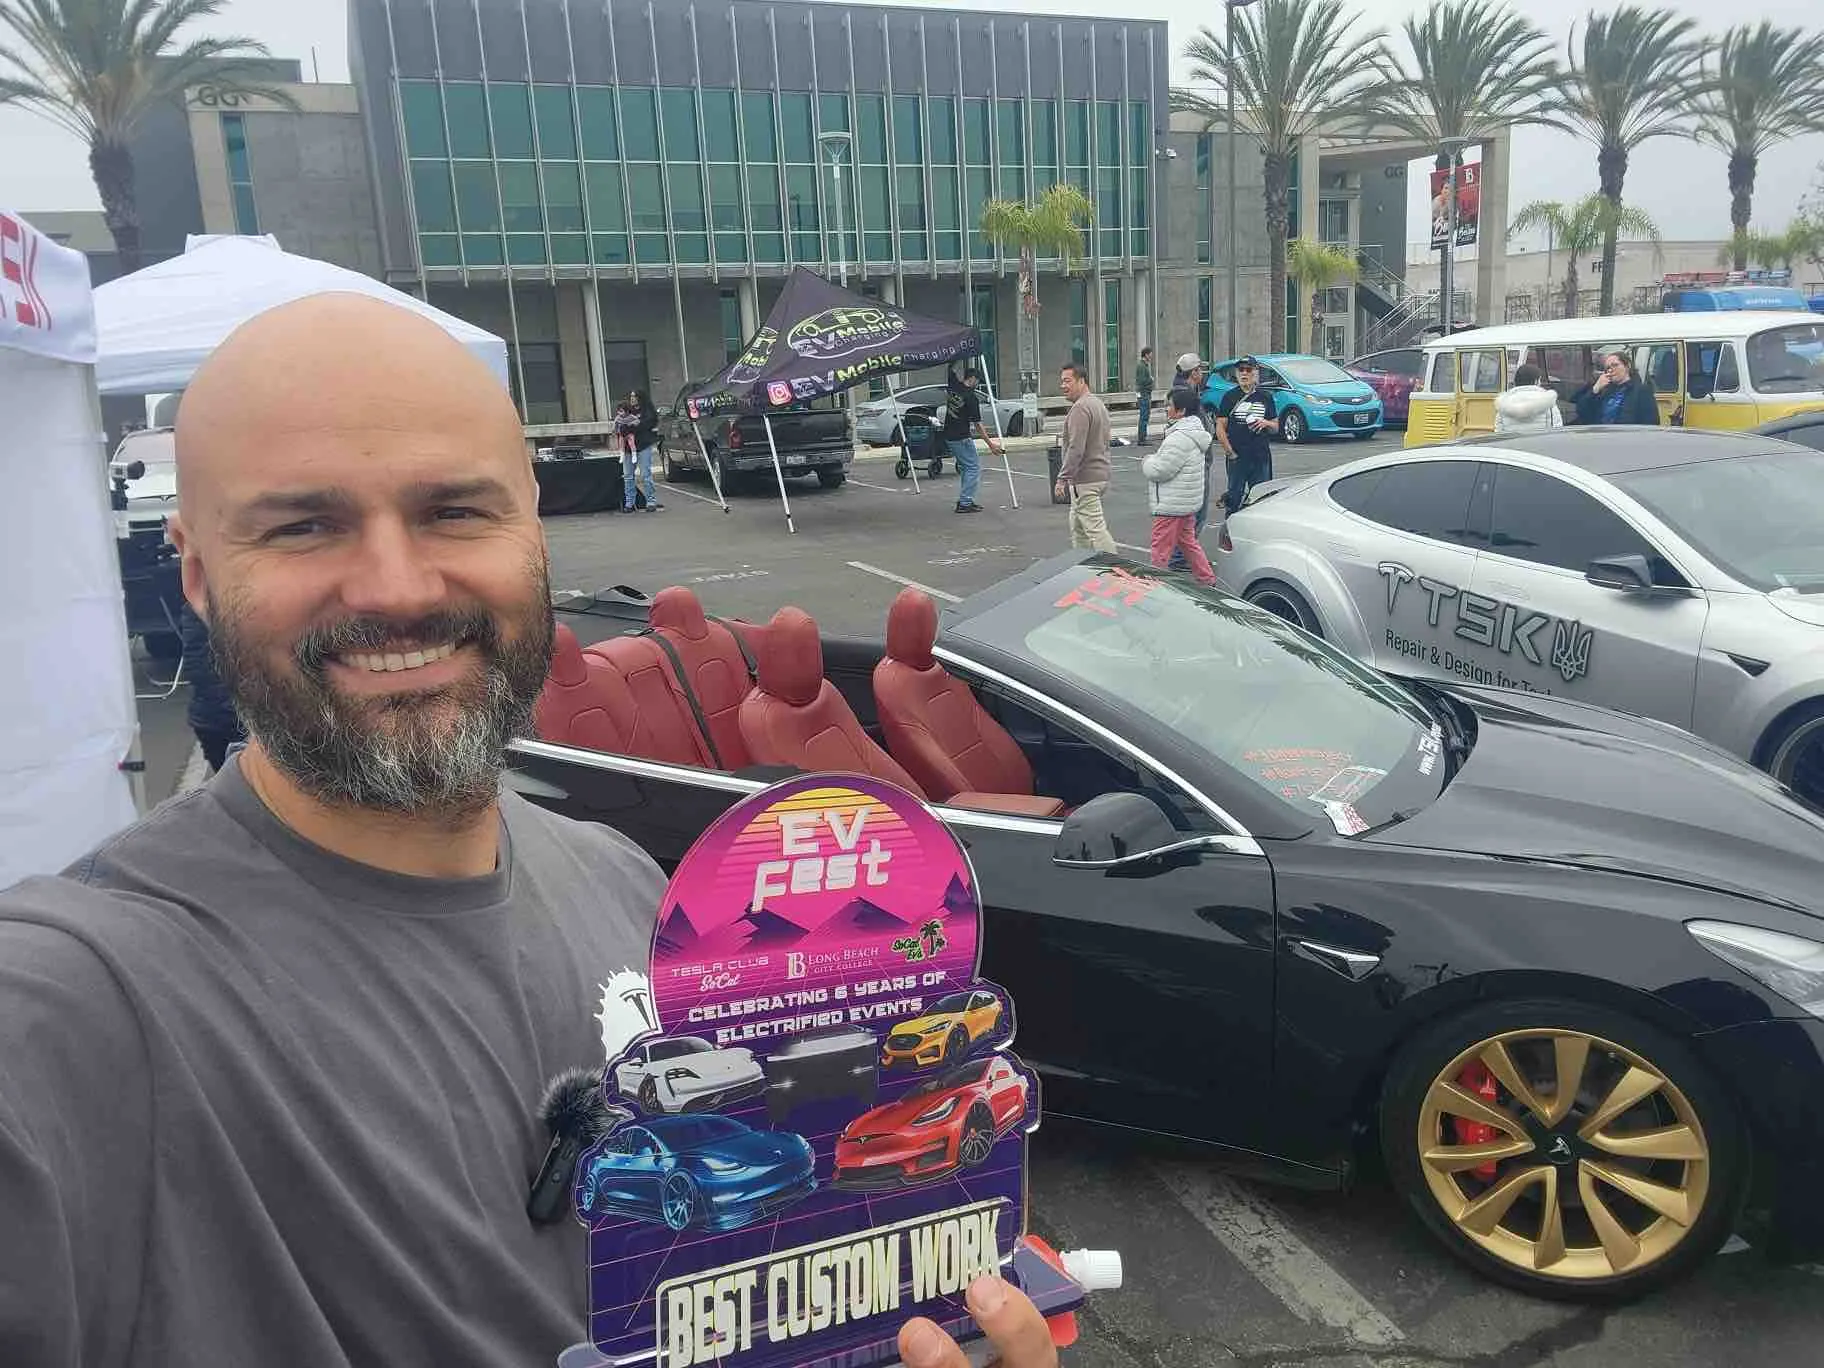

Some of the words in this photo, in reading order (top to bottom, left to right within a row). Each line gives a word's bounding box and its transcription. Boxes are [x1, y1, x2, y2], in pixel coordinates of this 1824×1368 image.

[1418, 575, 1551, 664] TSK
[1385, 629, 1427, 661] Repair
[1430, 646, 1441, 665] &
[1444, 651, 1493, 686] Design
[778, 807, 872, 856] EV
[751, 838, 892, 913] Fest
[672, 962, 722, 977] TESLA
[727, 956, 769, 970] CLUB
[808, 952, 840, 965] LONG
[843, 946, 880, 961] BEACH
[814, 965, 833, 974] CITY
[837, 959, 873, 971] COLLEGE
[688, 988, 828, 1023] CELEBRATING
[834, 985, 848, 999] 6
[855, 975, 917, 997] YEARS
[922, 970, 947, 986] OF
[700, 972, 741, 992] SoCal
[716, 1010, 844, 1043] ELECTRIFIED
[850, 997, 923, 1021] EVENTS
[668, 1270, 757, 1368] BEST
[767, 1233, 901, 1343] CUSTOM
[910, 1208, 1001, 1304] WORK
